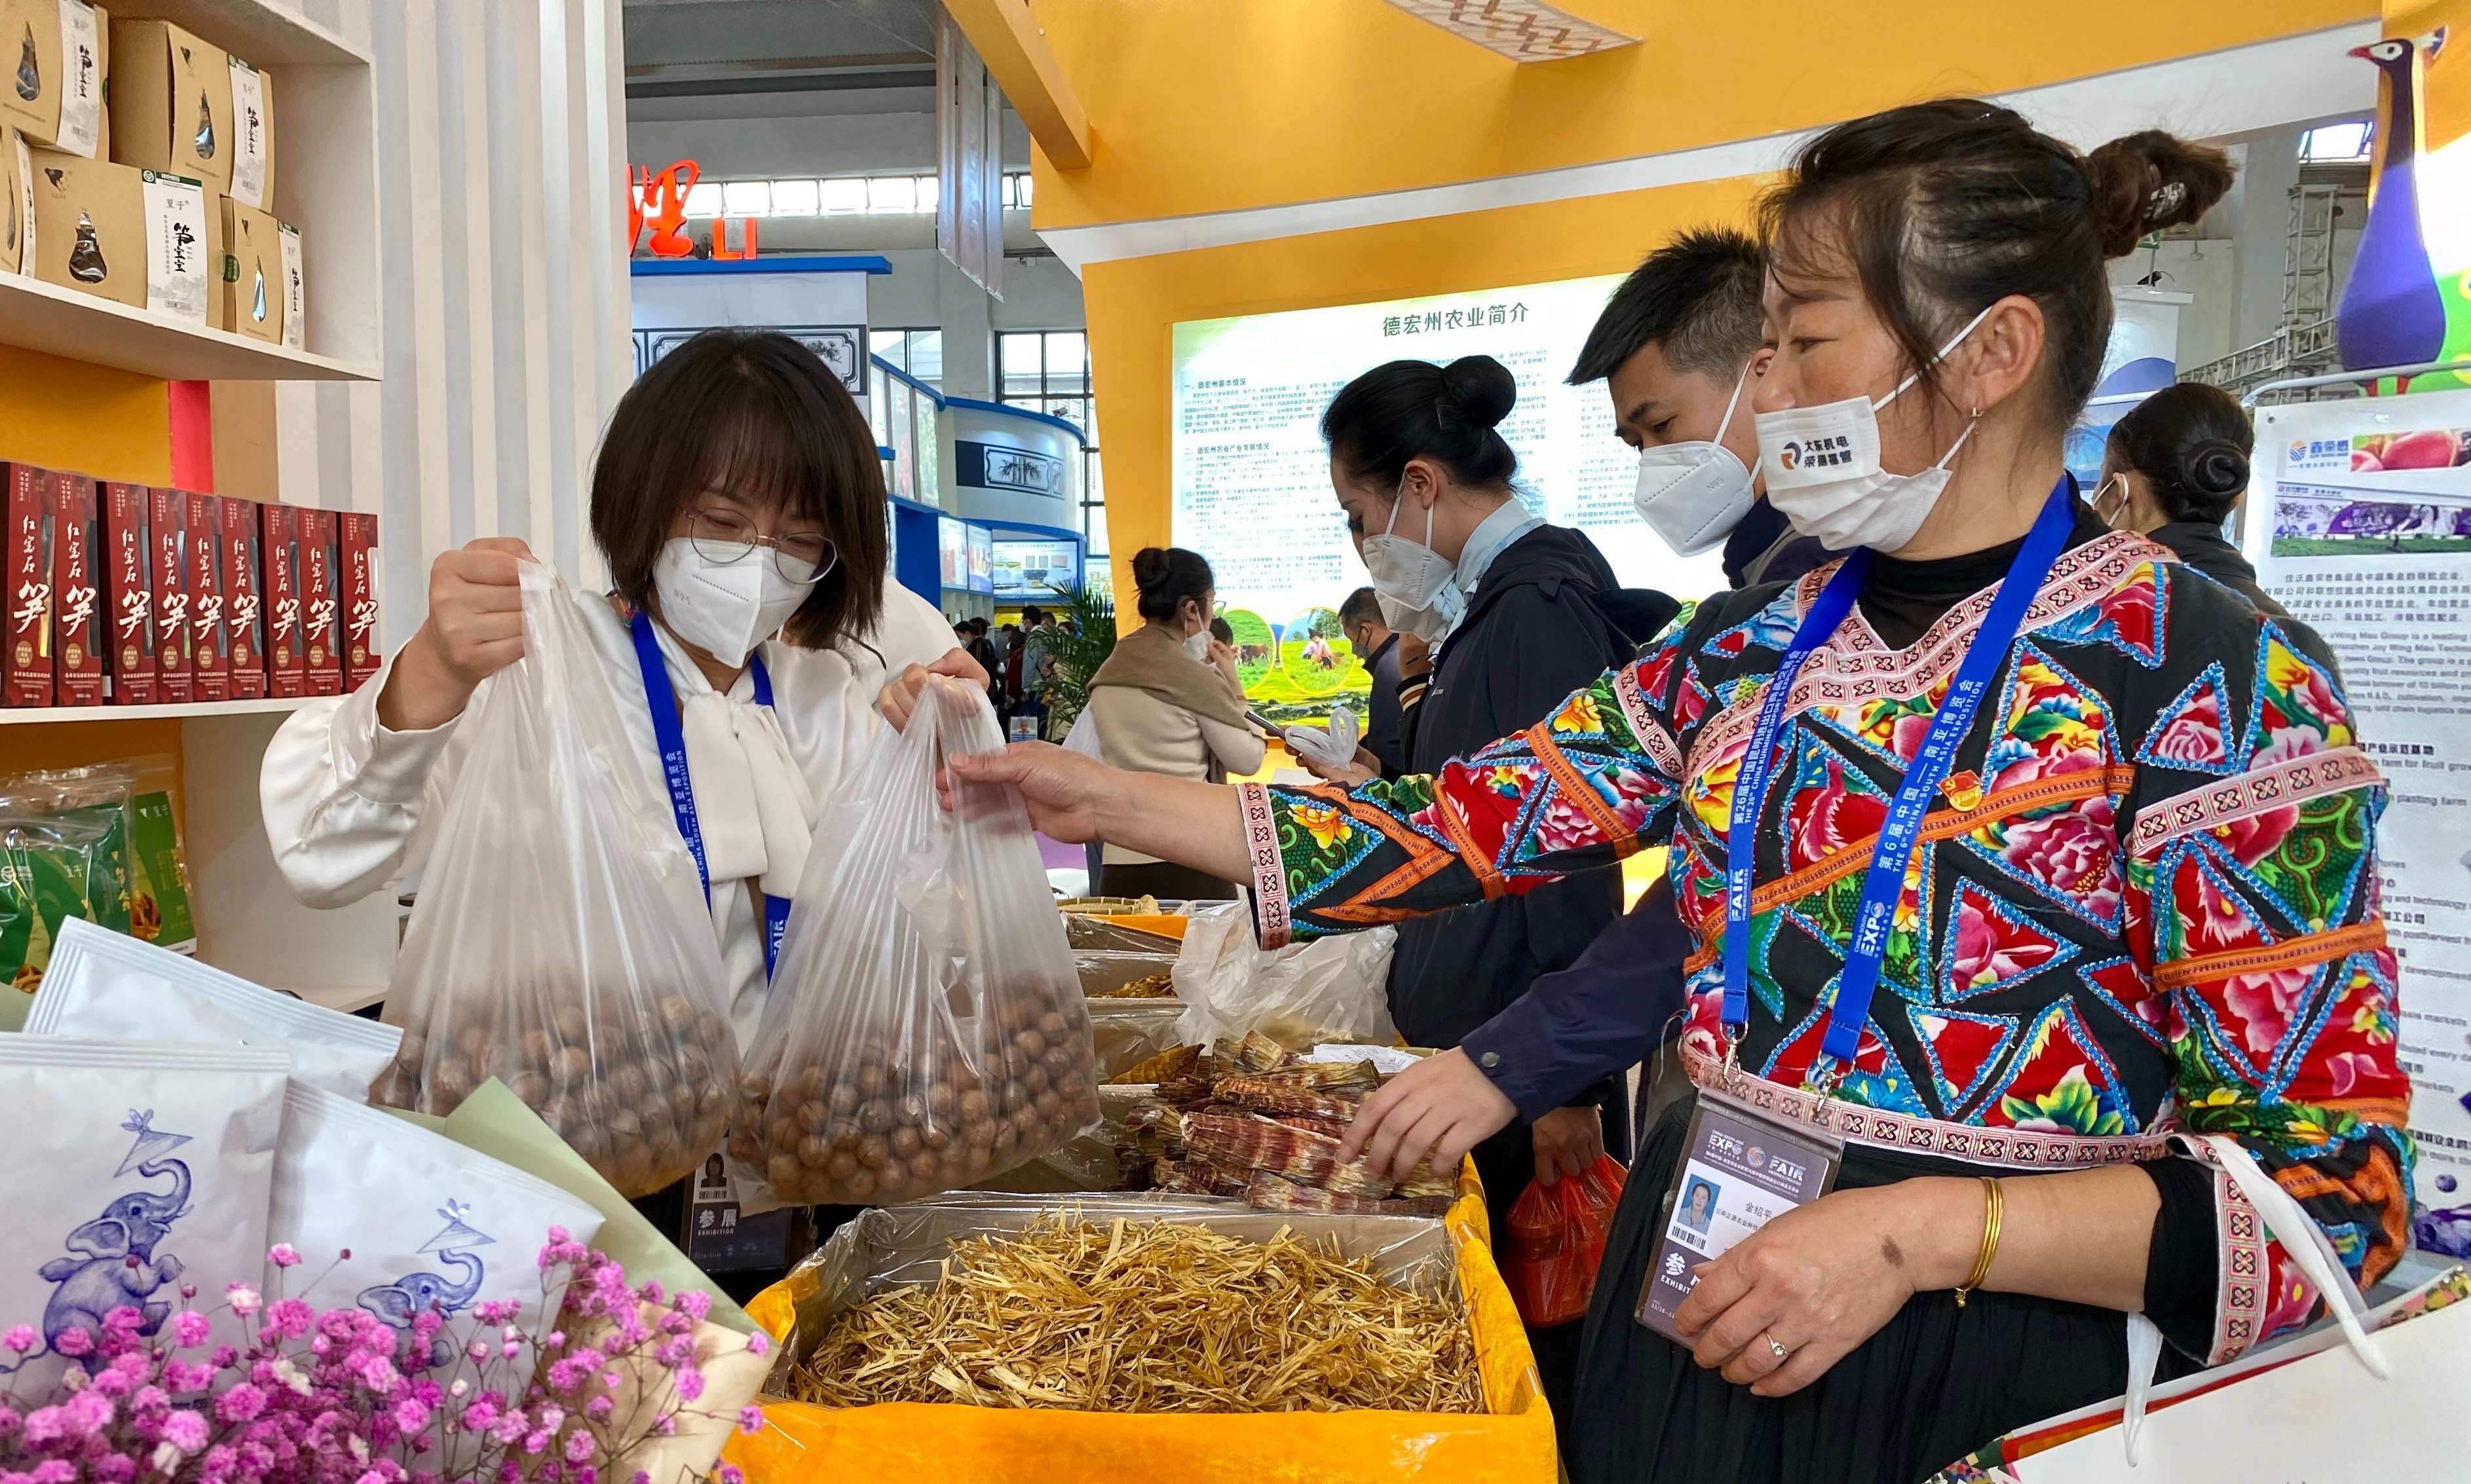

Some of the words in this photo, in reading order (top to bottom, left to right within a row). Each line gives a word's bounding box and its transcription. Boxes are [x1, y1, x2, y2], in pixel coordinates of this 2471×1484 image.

[1382, 302, 1530, 337] 德宏州农业简介
[14, 580, 50, 634] 笋
[62, 584, 97, 637] 笋
[119, 589, 151, 640] 笋
[160, 591, 189, 640] 笋
[195, 593, 224, 640] 笋
[231, 593, 260, 640] 笋
[273, 597, 300, 640] 笋
[307, 598, 336, 640] 笋
[349, 599, 377, 640] 笋
[677, 750, 691, 796] EXPOSITION
[1745, 807, 1754, 823] THE
[1752, 764, 1764, 789] CHINA
[1760, 728, 1773, 764] KUNMING
[1770, 698, 1782, 727] IMPORT
[1894, 853, 1905, 873] THE
[1936, 739, 1953, 763] ASIA
[1949, 680, 1984, 739] EXPOSITION
[1731, 868, 1745, 921] FAIR
[1859, 902, 1885, 957] EXPO
[1708, 1134, 1743, 1155] EXPO
[1661, 1274, 1691, 1294] EXHIBIT
